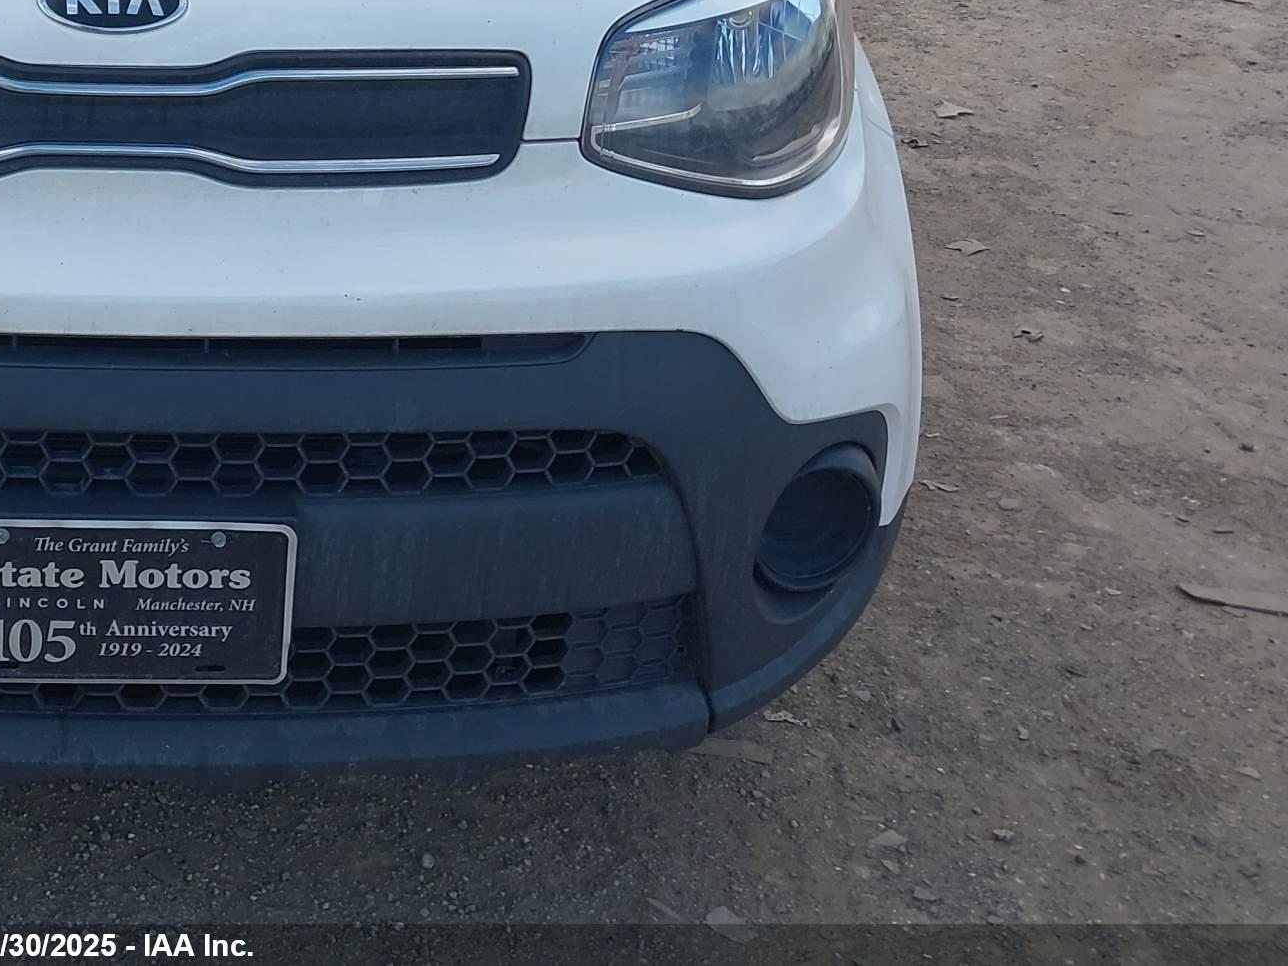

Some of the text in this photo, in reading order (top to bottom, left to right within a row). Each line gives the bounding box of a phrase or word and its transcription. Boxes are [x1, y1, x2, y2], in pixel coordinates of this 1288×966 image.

[34, 537, 189, 557] The Grant Family's
[99, 559, 251, 589] Motors
[135, 598, 256, 612] Manchester, NH
[105, 620, 233, 642] Anniversary
[98, 643, 142, 657] 1919
[157, 643, 202, 657] 2024
